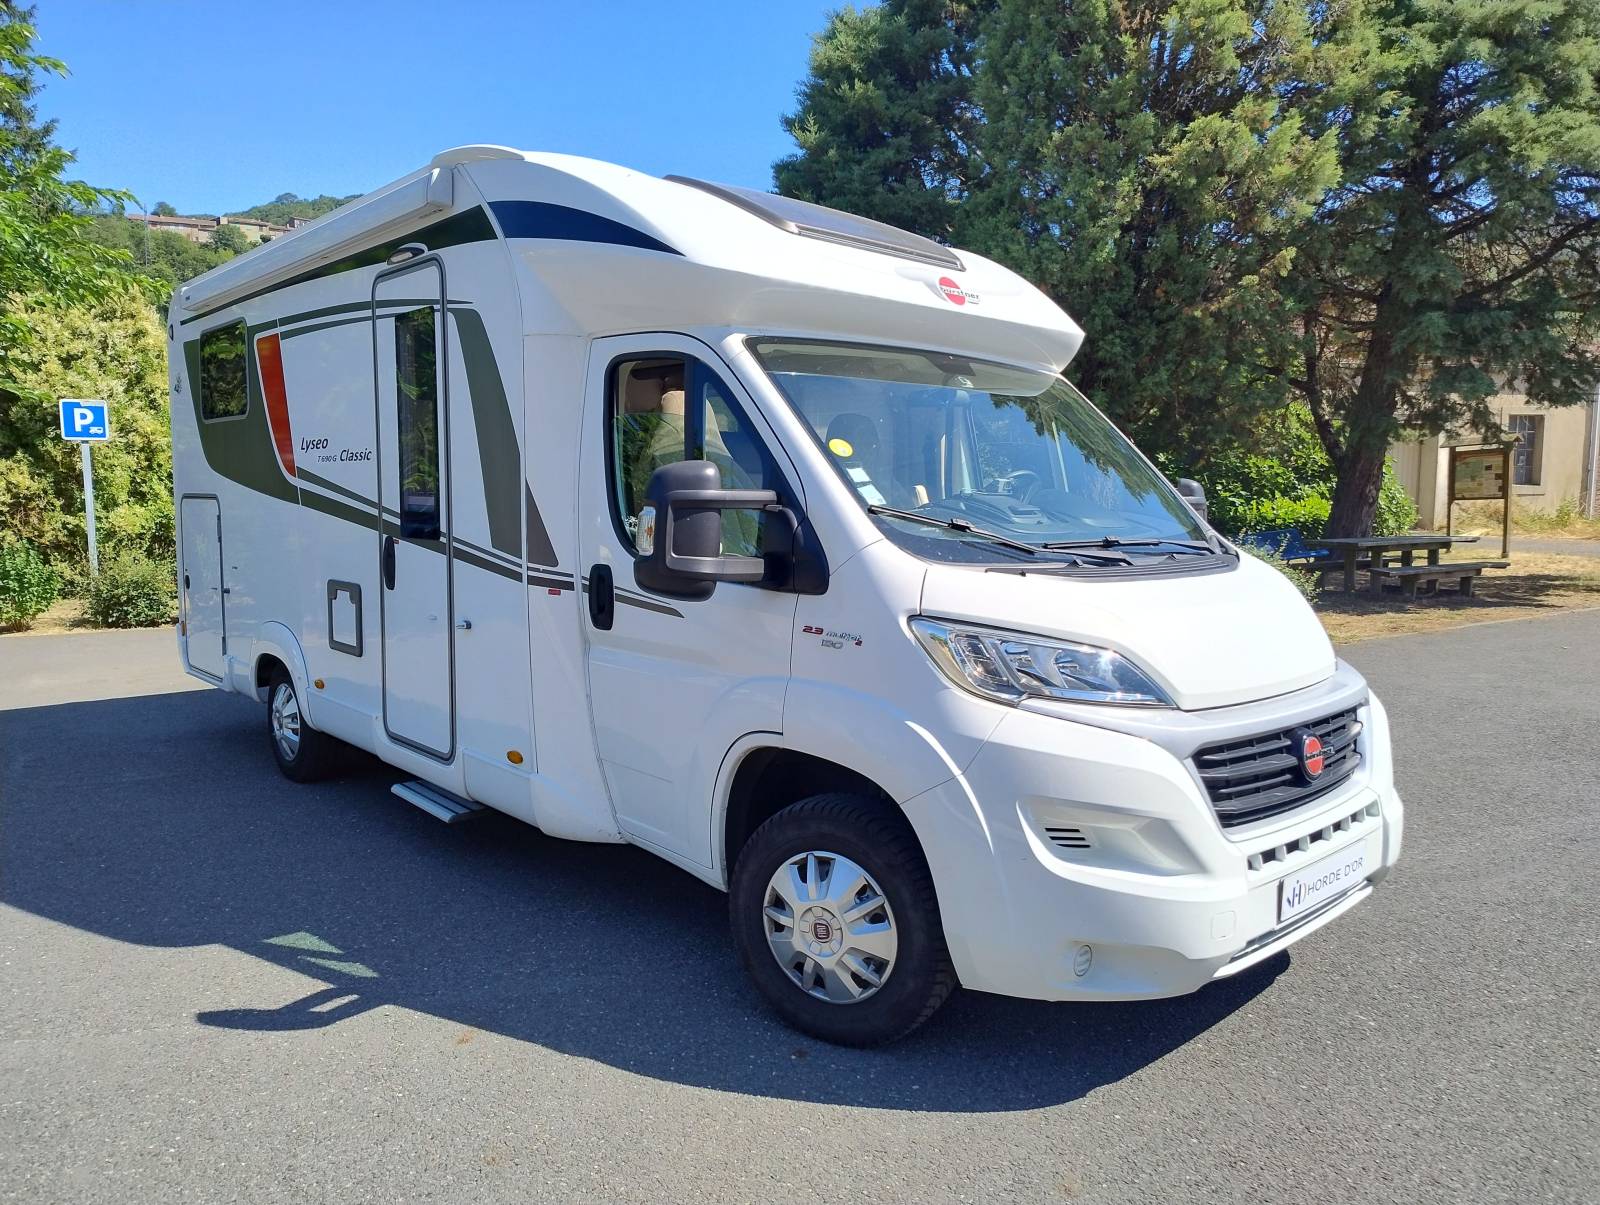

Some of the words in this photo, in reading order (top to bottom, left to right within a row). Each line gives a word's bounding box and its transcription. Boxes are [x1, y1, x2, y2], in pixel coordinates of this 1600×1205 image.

[73, 407, 94, 432] P
[300, 437, 329, 454] Lyseo
[339, 447, 373, 462] Classic
[1307, 868, 1342, 896] HORDE
